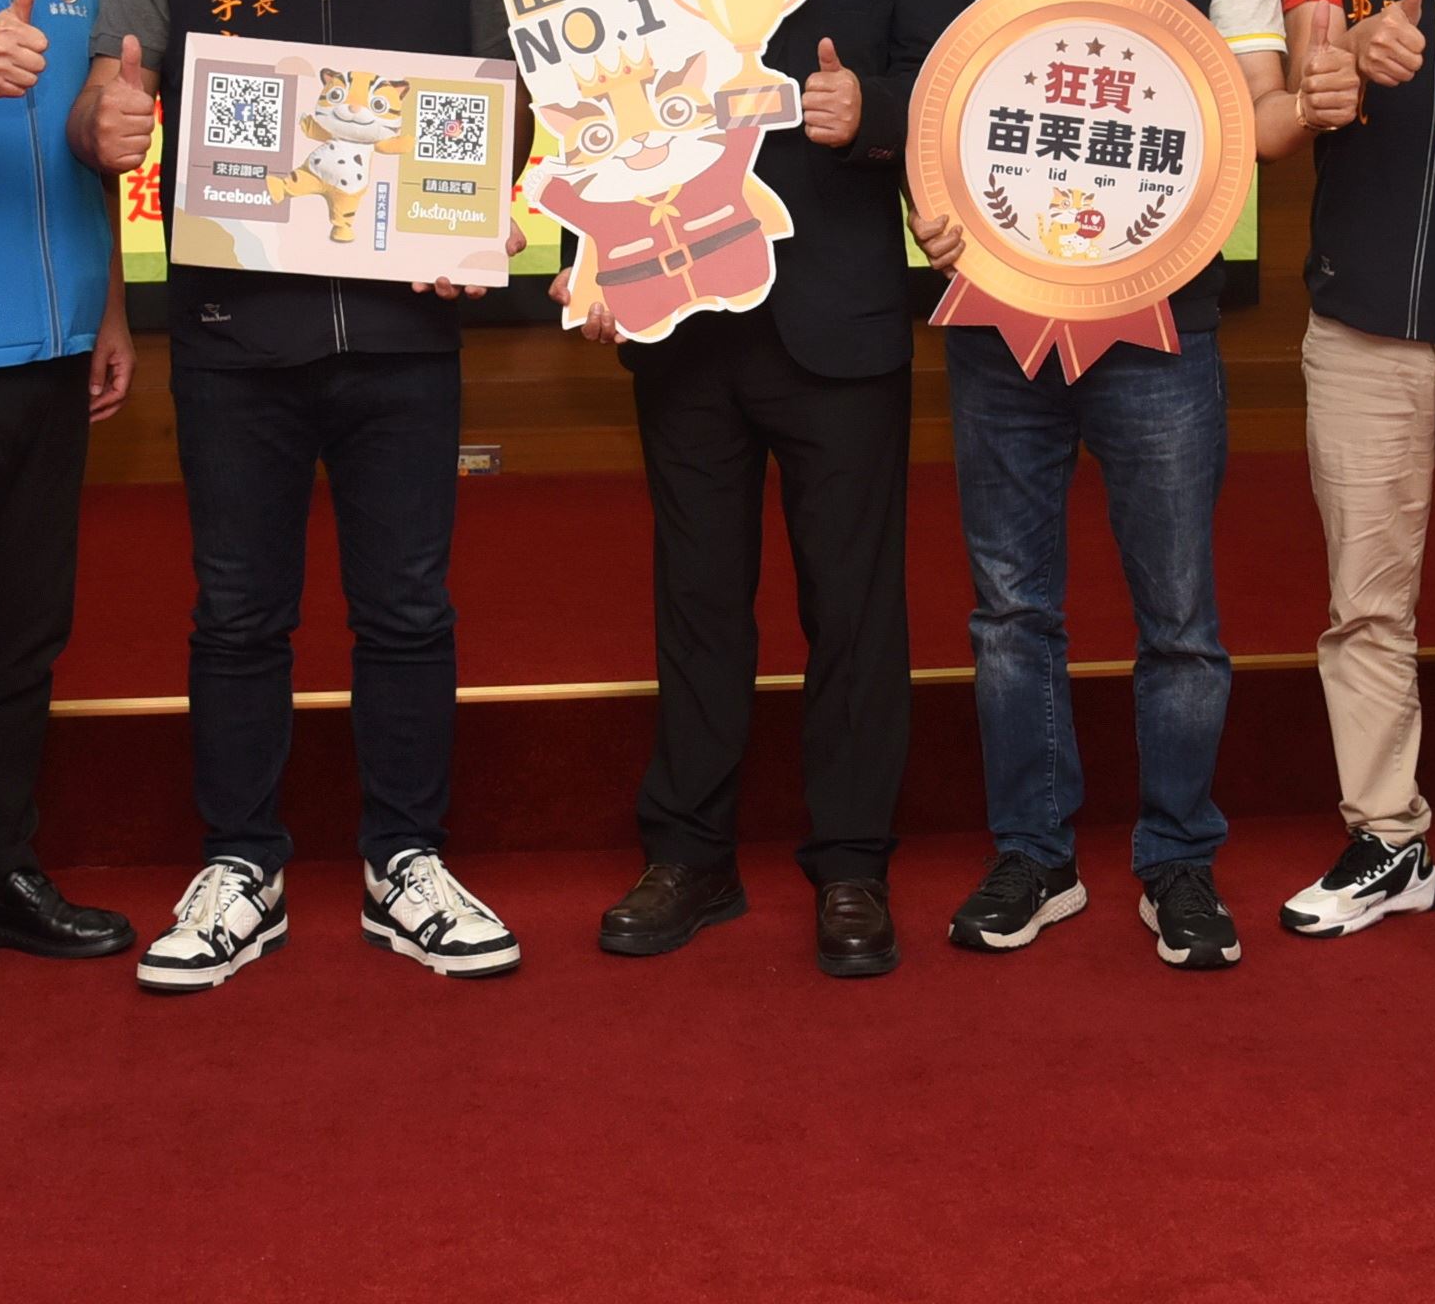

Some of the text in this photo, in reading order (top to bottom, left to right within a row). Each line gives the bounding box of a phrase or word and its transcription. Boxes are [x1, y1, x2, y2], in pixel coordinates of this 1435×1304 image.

[1044, 61, 1136, 114] 狂賀
[987, 106, 1186, 176] 苗栗盡靚
[1048, 167, 1067, 182] lid
[1094, 174, 1116, 188] qin
[203, 185, 272, 206] facebook
[407, 201, 487, 231] Instagram
